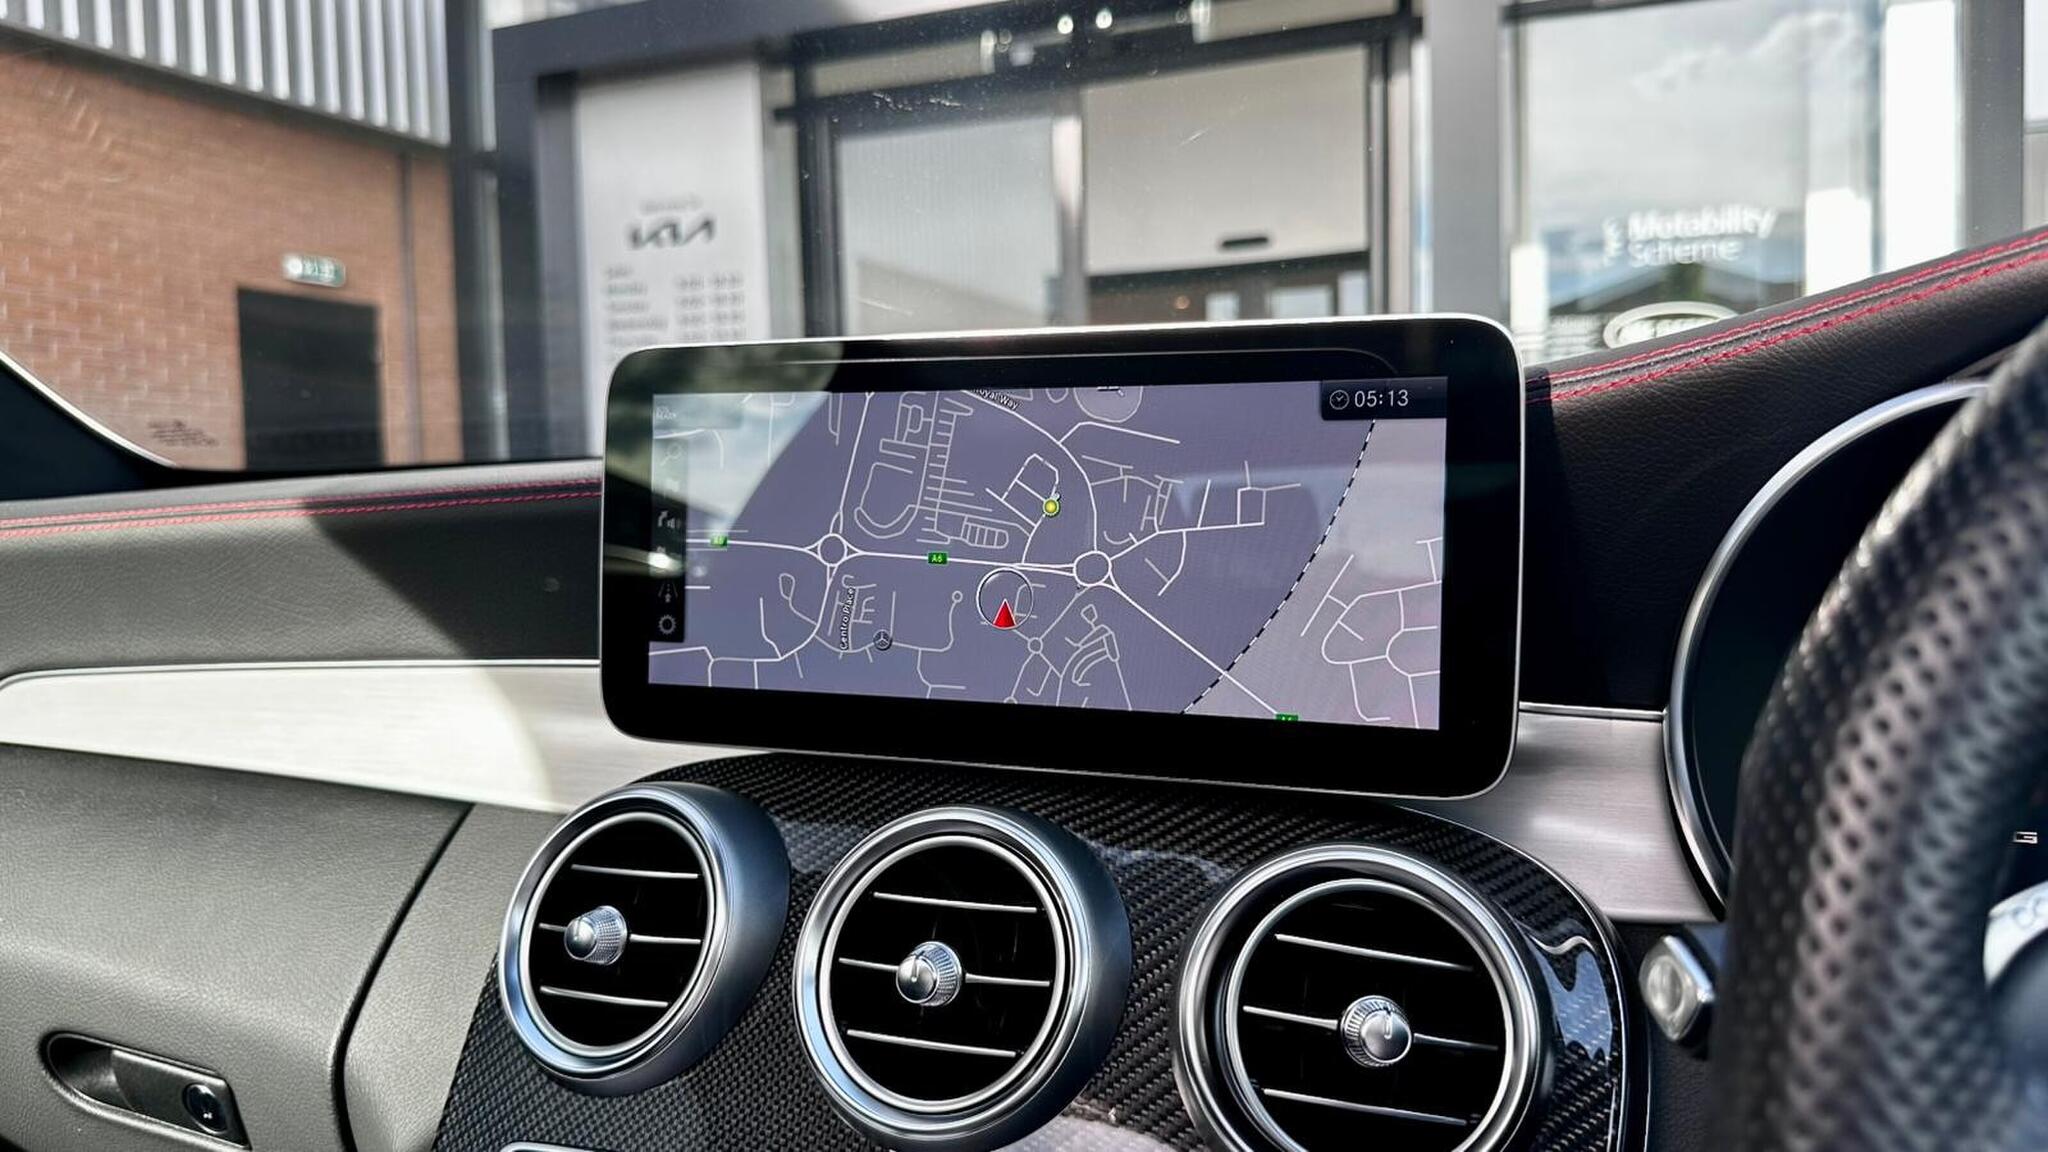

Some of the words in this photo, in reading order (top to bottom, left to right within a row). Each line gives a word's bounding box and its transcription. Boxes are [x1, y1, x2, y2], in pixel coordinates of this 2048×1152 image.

[1627, 204, 1777, 242] Motability
[1627, 238, 1741, 268] Scheme
[1354, 389, 1409, 408] 05:13
